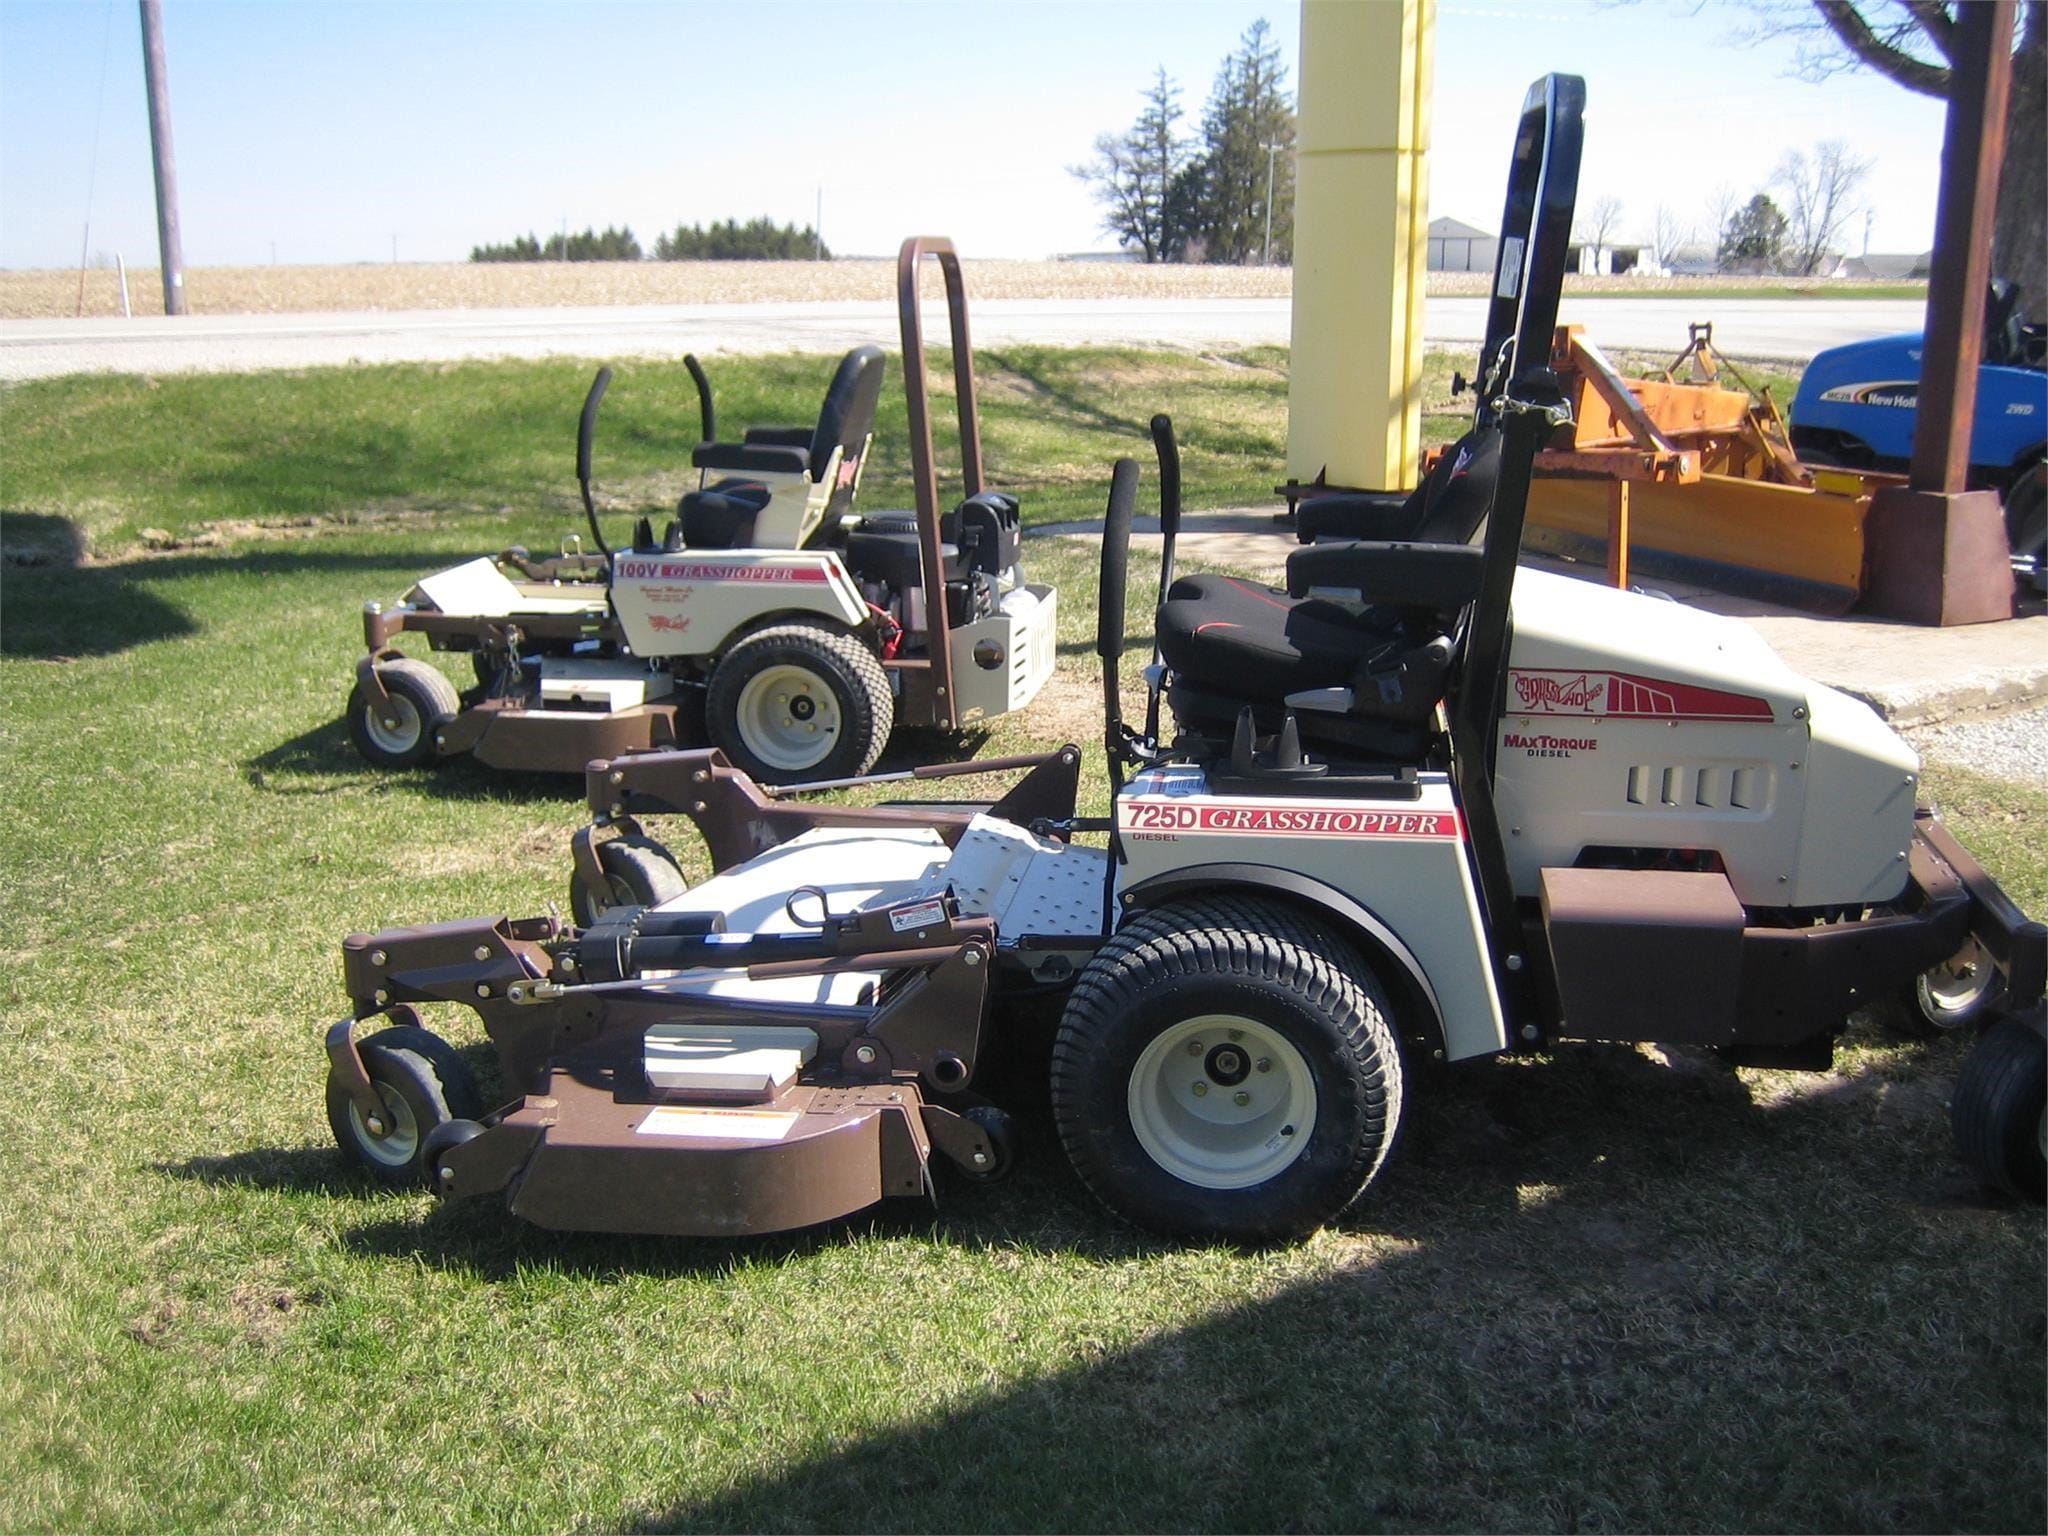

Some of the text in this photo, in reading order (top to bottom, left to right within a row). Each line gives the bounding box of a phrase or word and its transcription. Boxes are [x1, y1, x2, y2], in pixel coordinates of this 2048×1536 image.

[1868, 392, 1918, 409] New Holl
[619, 563, 793, 580] 100V GRASSHOPPER
[1504, 735, 1597, 750] MAXTORQUE
[1527, 750, 1571, 758] DIESEL
[1128, 804, 1439, 834] 725D GRASSHOPPER
[1132, 833, 1179, 842] DIESEL
